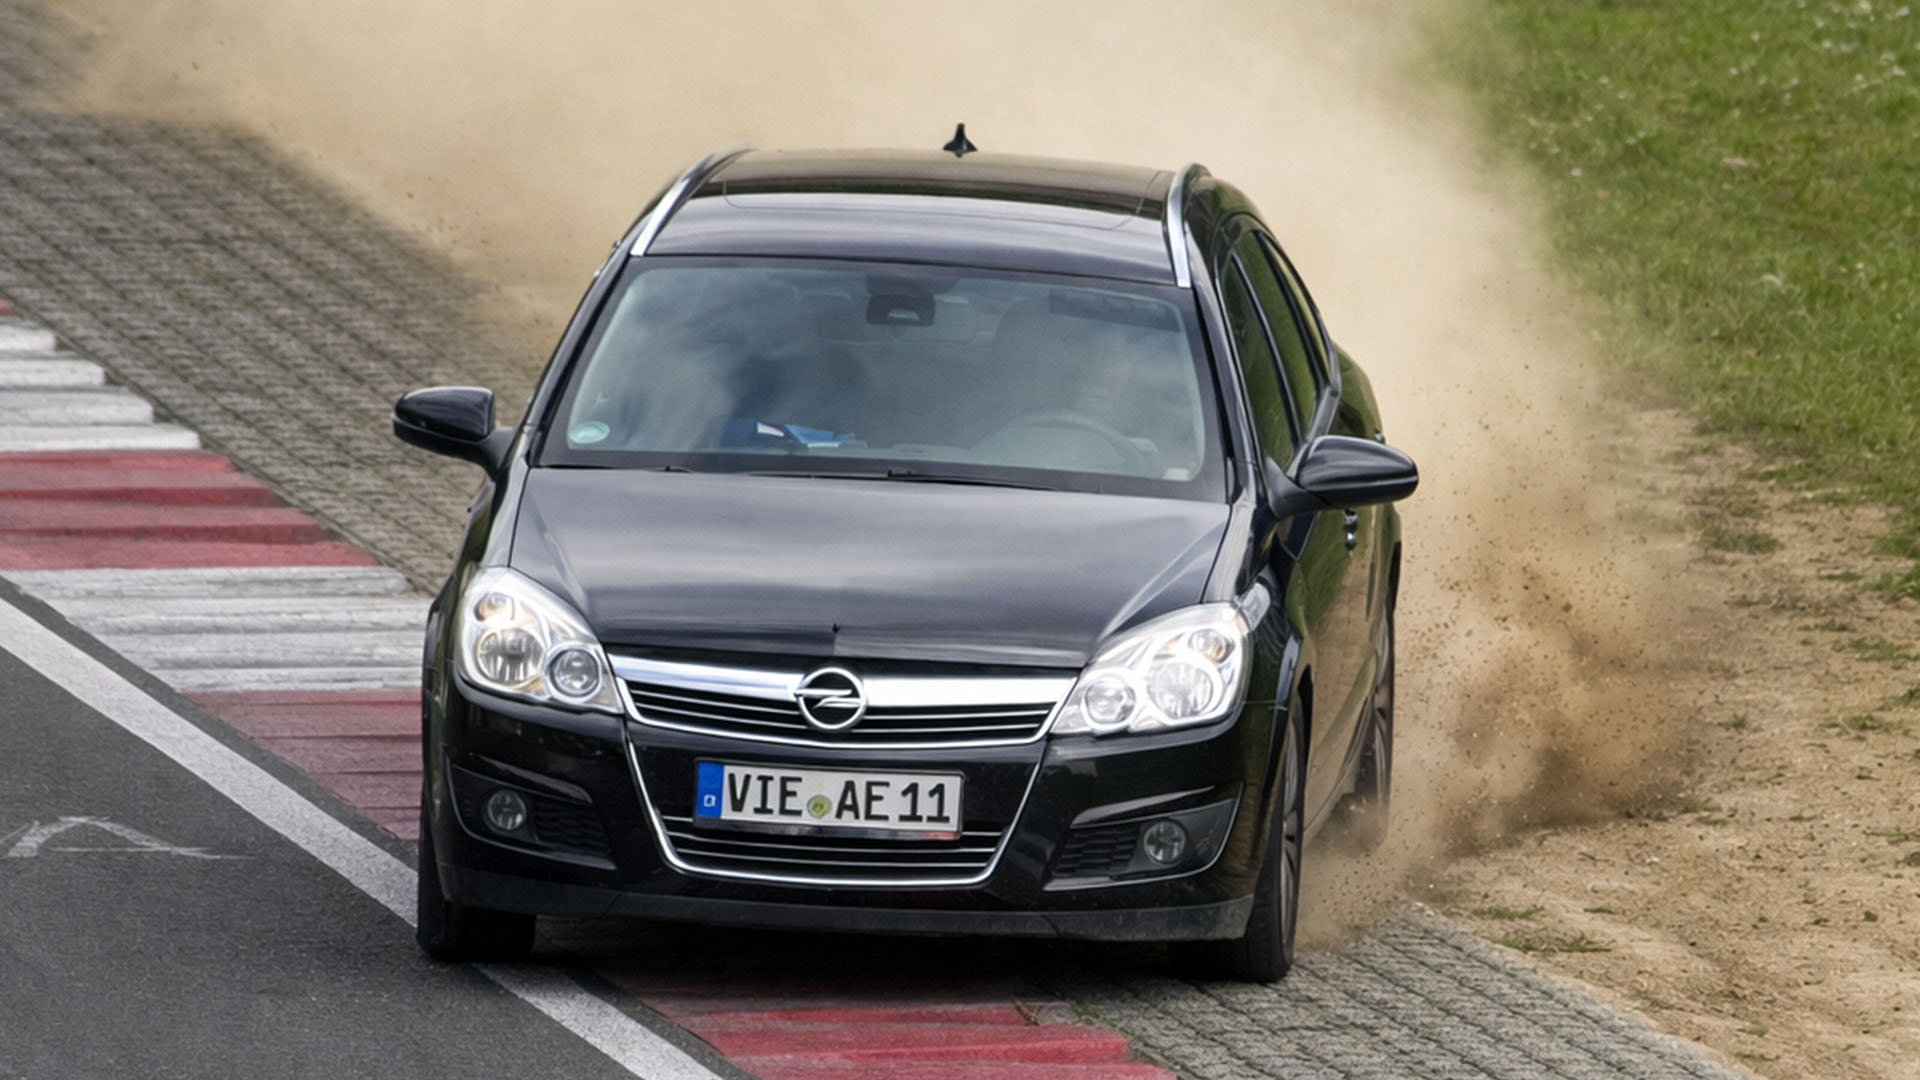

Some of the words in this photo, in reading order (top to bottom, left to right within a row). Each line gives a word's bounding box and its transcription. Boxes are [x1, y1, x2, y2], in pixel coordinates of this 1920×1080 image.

[727, 772, 803, 816] VIE
[835, 780, 890, 821] AE
[898, 782, 950, 824] 11
